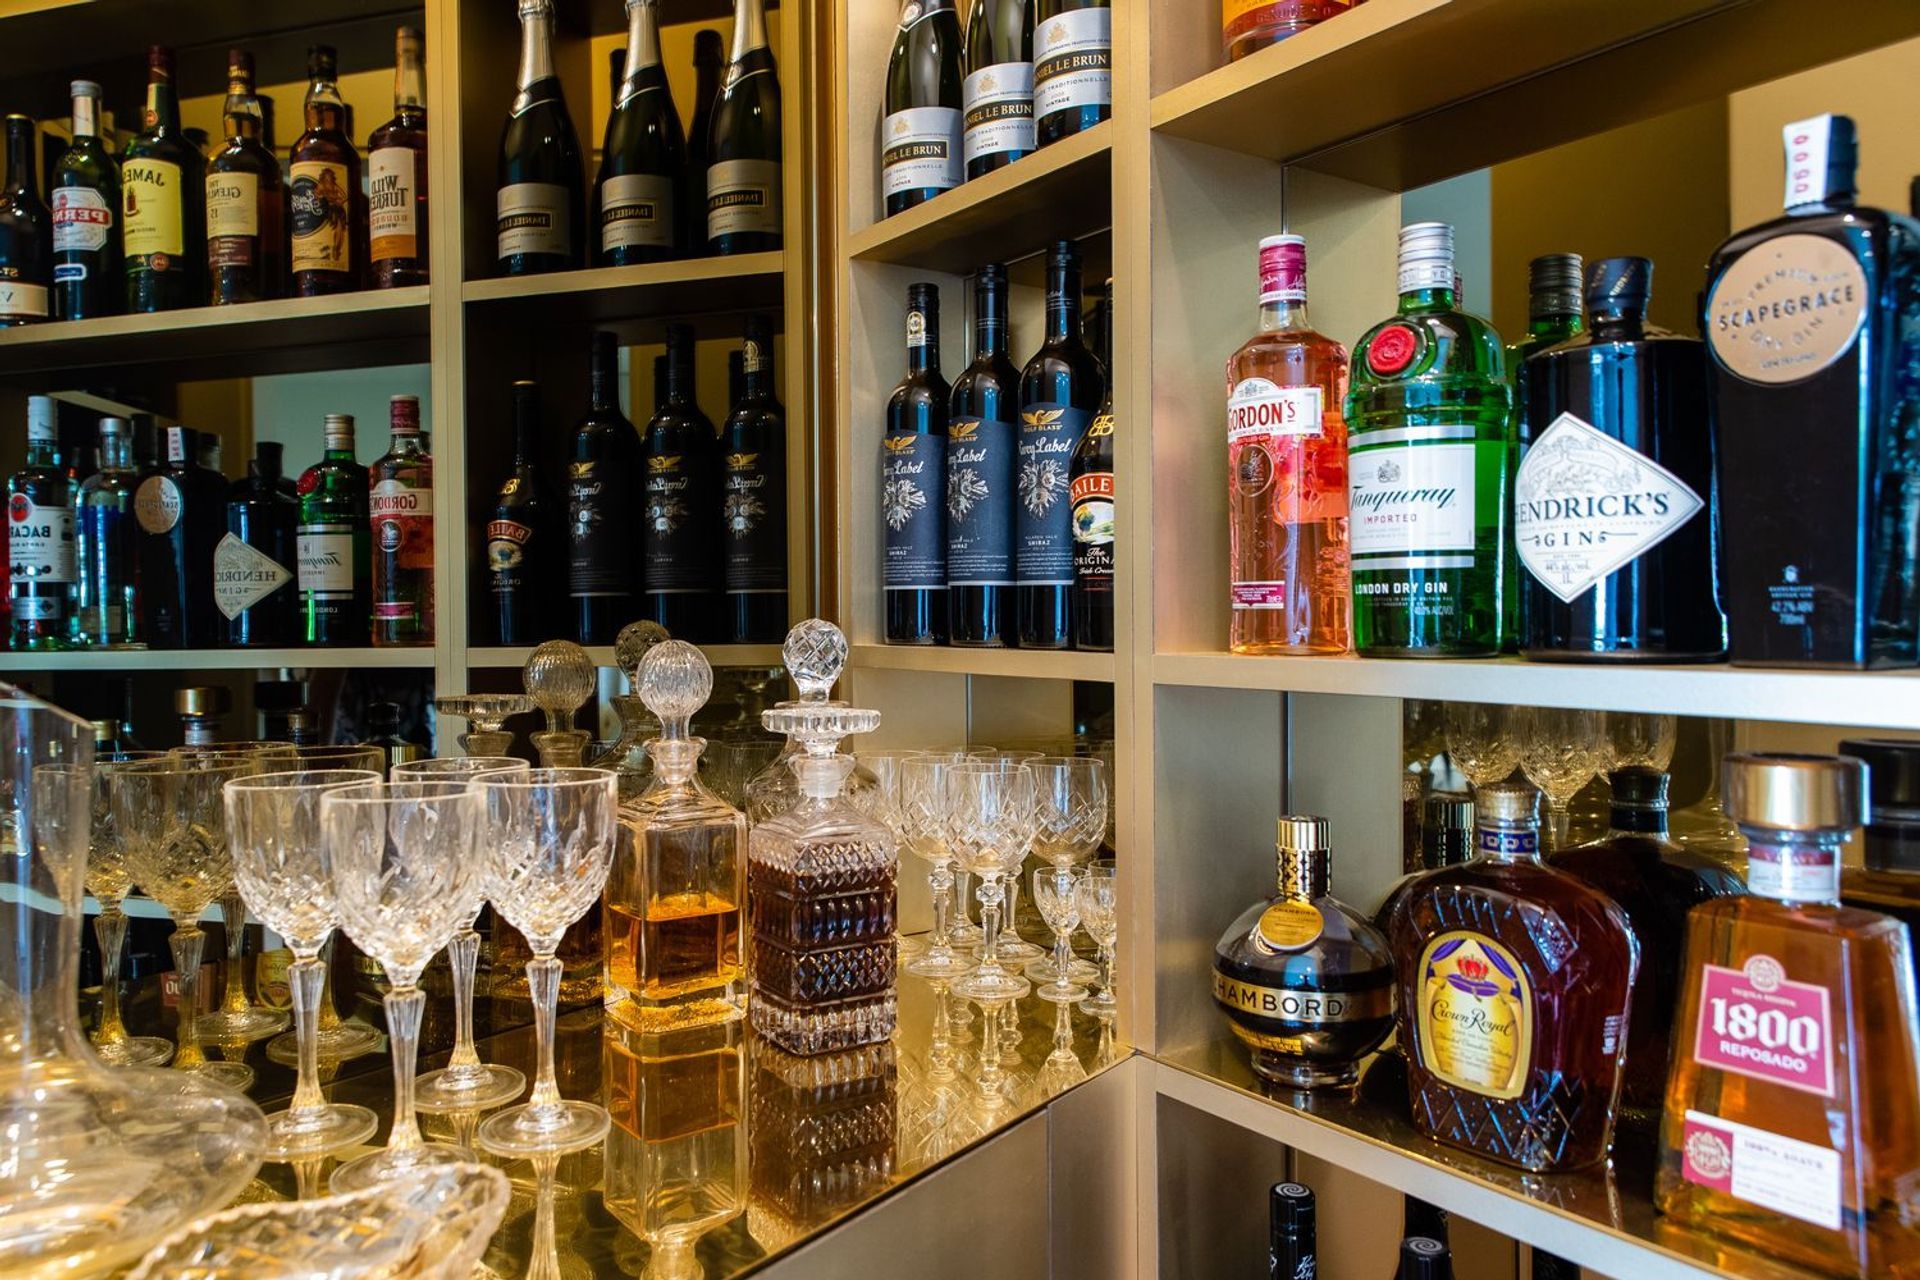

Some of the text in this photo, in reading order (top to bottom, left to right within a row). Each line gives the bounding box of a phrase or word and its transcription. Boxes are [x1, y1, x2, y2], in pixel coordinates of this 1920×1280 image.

[1056, 58, 1070, 71] LE
[1072, 54, 1107, 68] BRUN
[986, 106, 999, 118] LE
[1000, 104, 1032, 115] BRUN
[900, 148, 911, 158] LE
[912, 145, 942, 156] BRUN
[1717, 285, 1853, 331] SCAPEGRACE
[1035, 436, 1072, 453] Label
[956, 448, 987, 463] Label
[893, 459, 924, 475] Label
[1351, 485, 1456, 512] Tanqueray
[1363, 514, 1418, 525] IMPORTED
[1544, 531, 1593, 546] GIN
[1355, 582, 1448, 594] LONDON DRY GIN
[1273, 907, 1317, 916] CHAMBORD
[1431, 1000, 1516, 1037] Crown Royal
[1710, 997, 1821, 1057] 1800
[1719, 1040, 1808, 1074] REPOSADO
